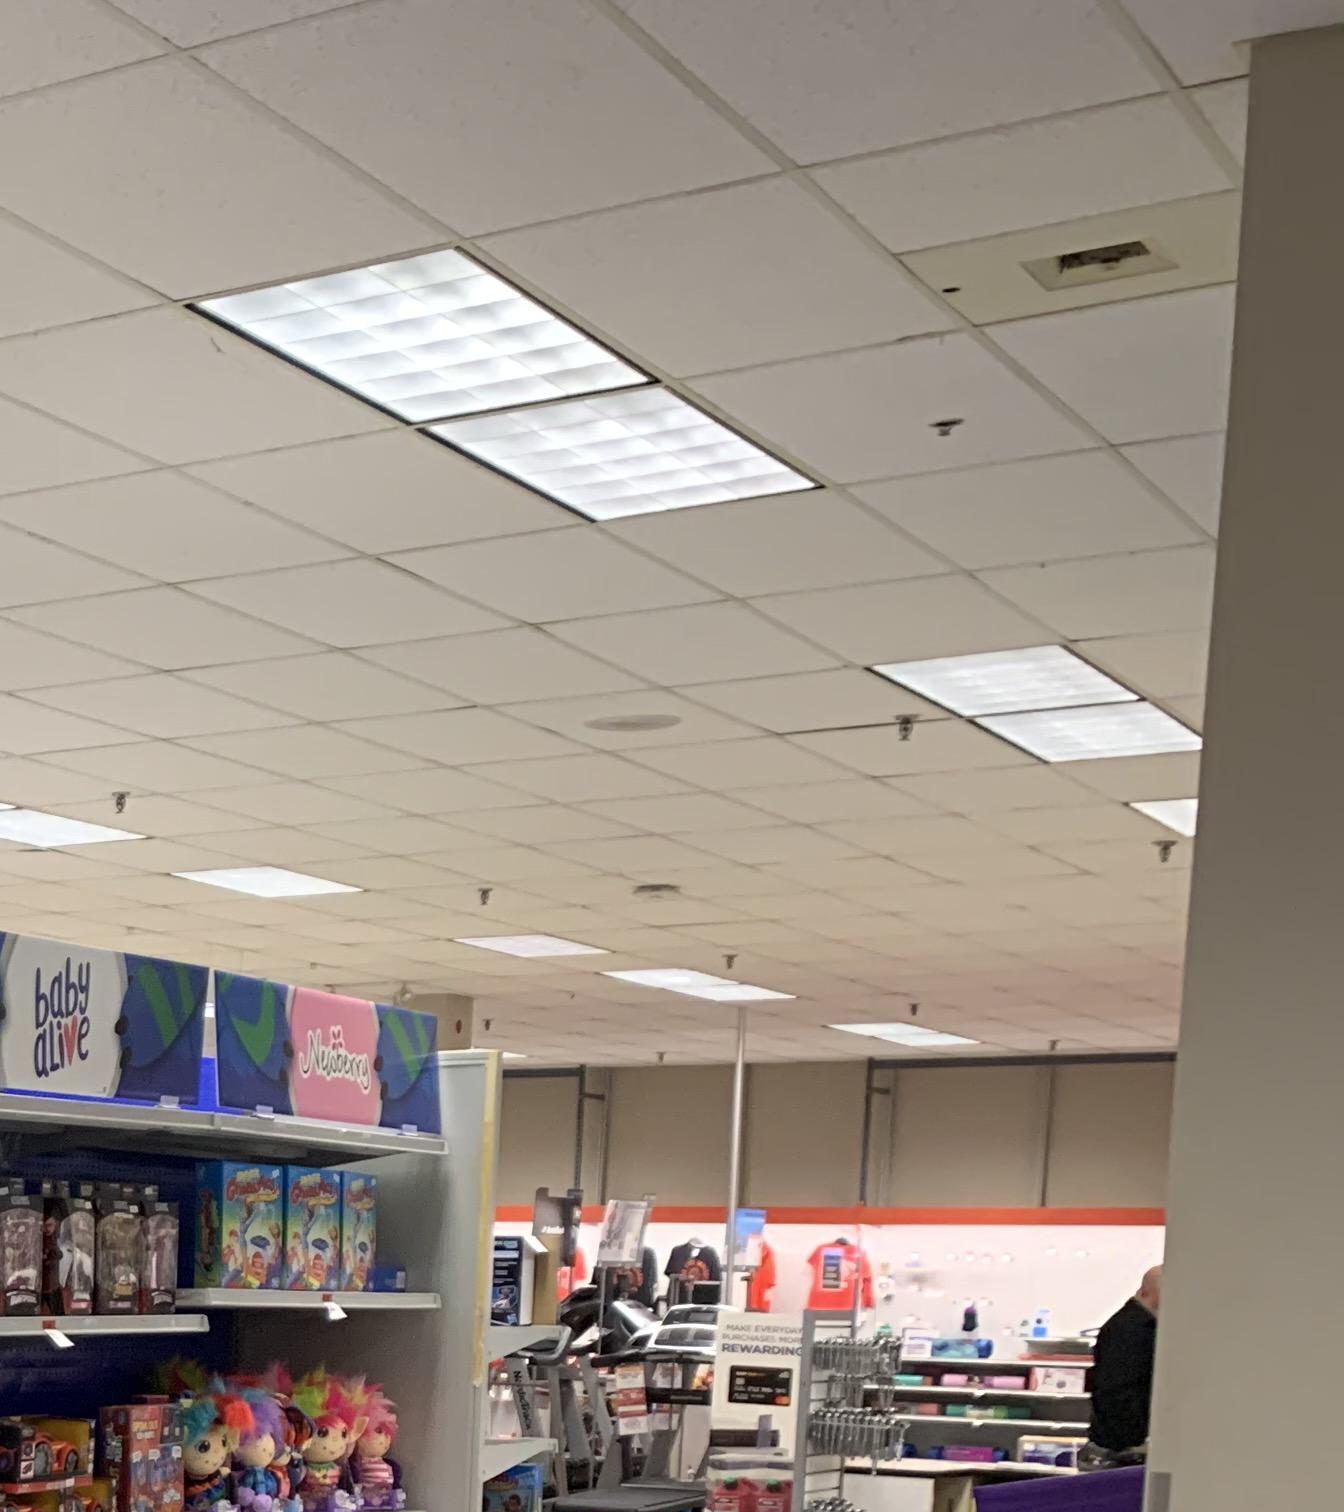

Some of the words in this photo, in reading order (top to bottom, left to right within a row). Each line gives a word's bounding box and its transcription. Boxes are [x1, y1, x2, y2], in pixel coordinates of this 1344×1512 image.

[35, 957, 90, 1028] baby
[299, 1029, 371, 1091] Newberry
[726, 1323, 752, 1332] MAKE
